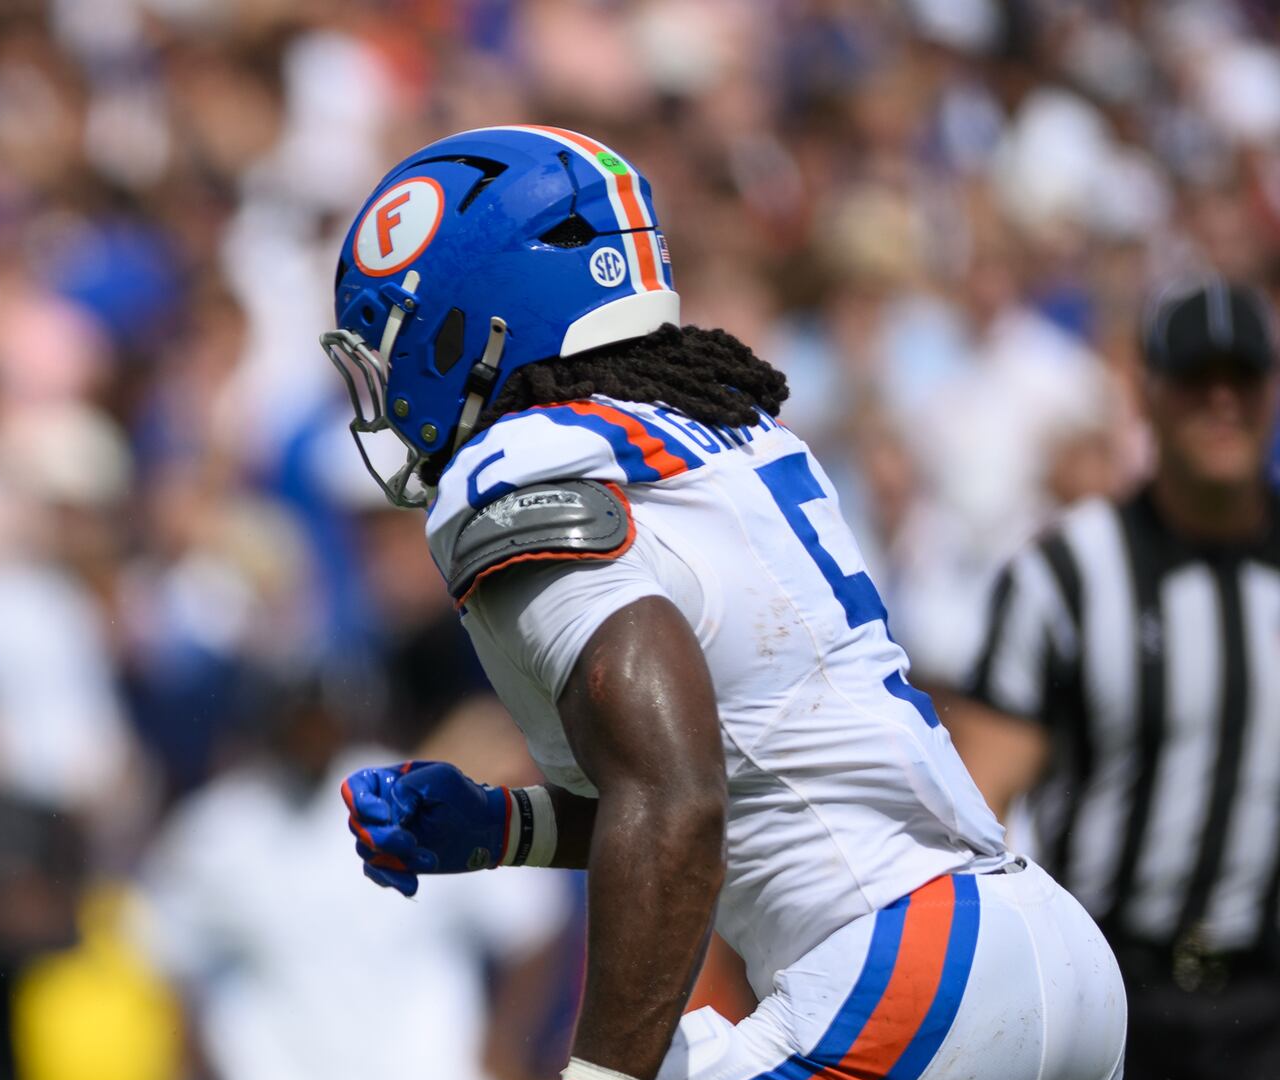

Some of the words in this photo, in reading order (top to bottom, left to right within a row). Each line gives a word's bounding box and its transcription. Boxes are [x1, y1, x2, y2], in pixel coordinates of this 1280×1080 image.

[376, 191, 411, 258] F
[594, 254, 624, 282] SEC
[752, 452, 941, 730] 5
